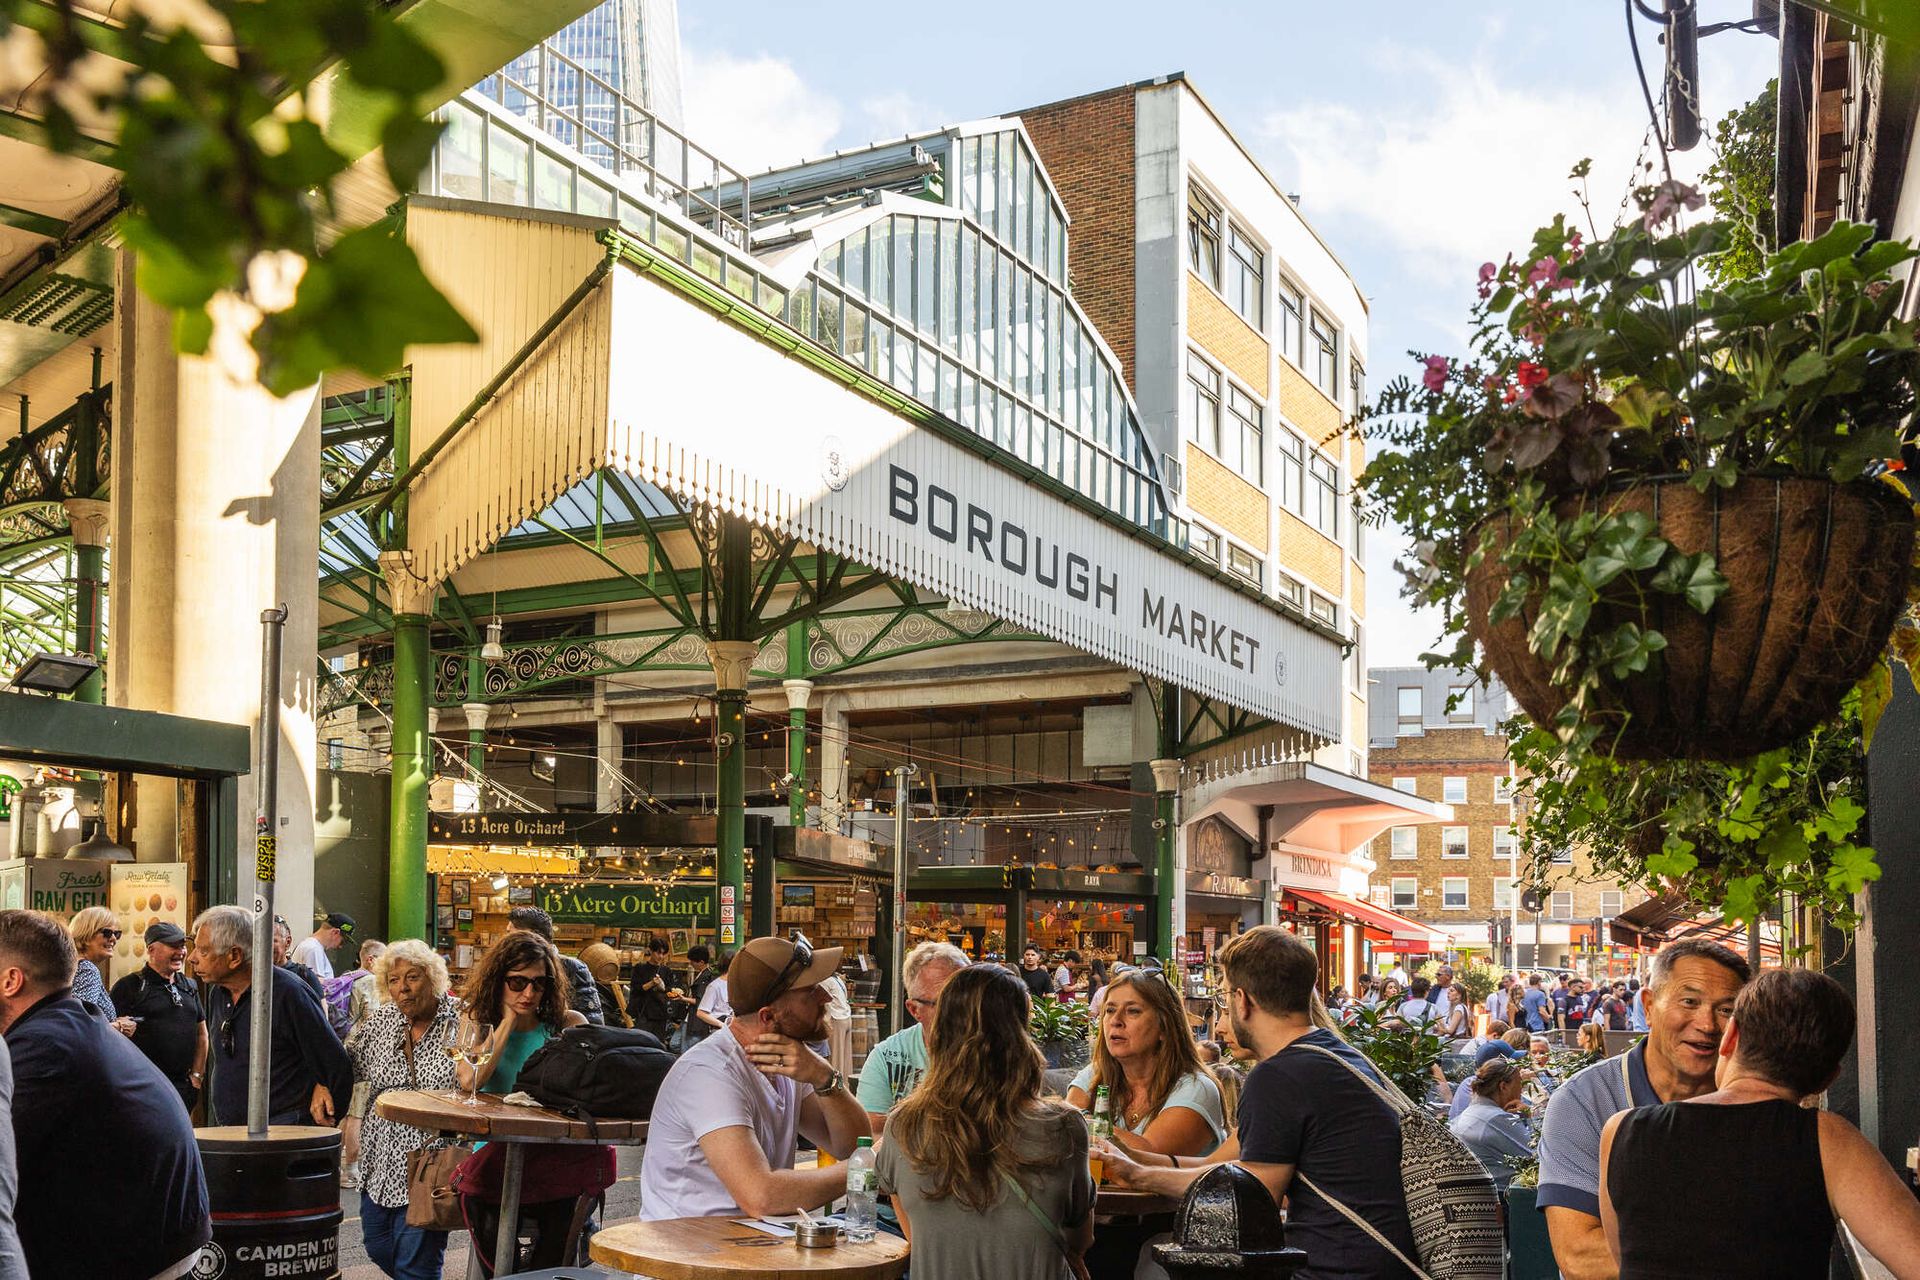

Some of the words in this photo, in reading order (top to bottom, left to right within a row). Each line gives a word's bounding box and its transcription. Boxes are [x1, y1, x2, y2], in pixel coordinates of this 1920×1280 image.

[889, 463, 1118, 616] BOROUGH
[1142, 587, 1260, 674] MARKET
[460, 818, 476, 834] 13
[481, 819, 510, 834] Acre
[515, 819, 565, 835] Orchard
[1291, 854, 1332, 877] BRINDISA
[56, 871, 106, 889] Fresh
[1084, 875, 1100, 887] RAYA
[1212, 874, 1241, 894] RAYA
[33, 890, 67, 912] RAW
[543, 894, 563, 914] 13
[566, 894, 616, 914] Acre
[620, 894, 710, 915] Orchard
[235, 1240, 318, 1262] CAMDEN
[264, 1252, 338, 1278] BREWERY
